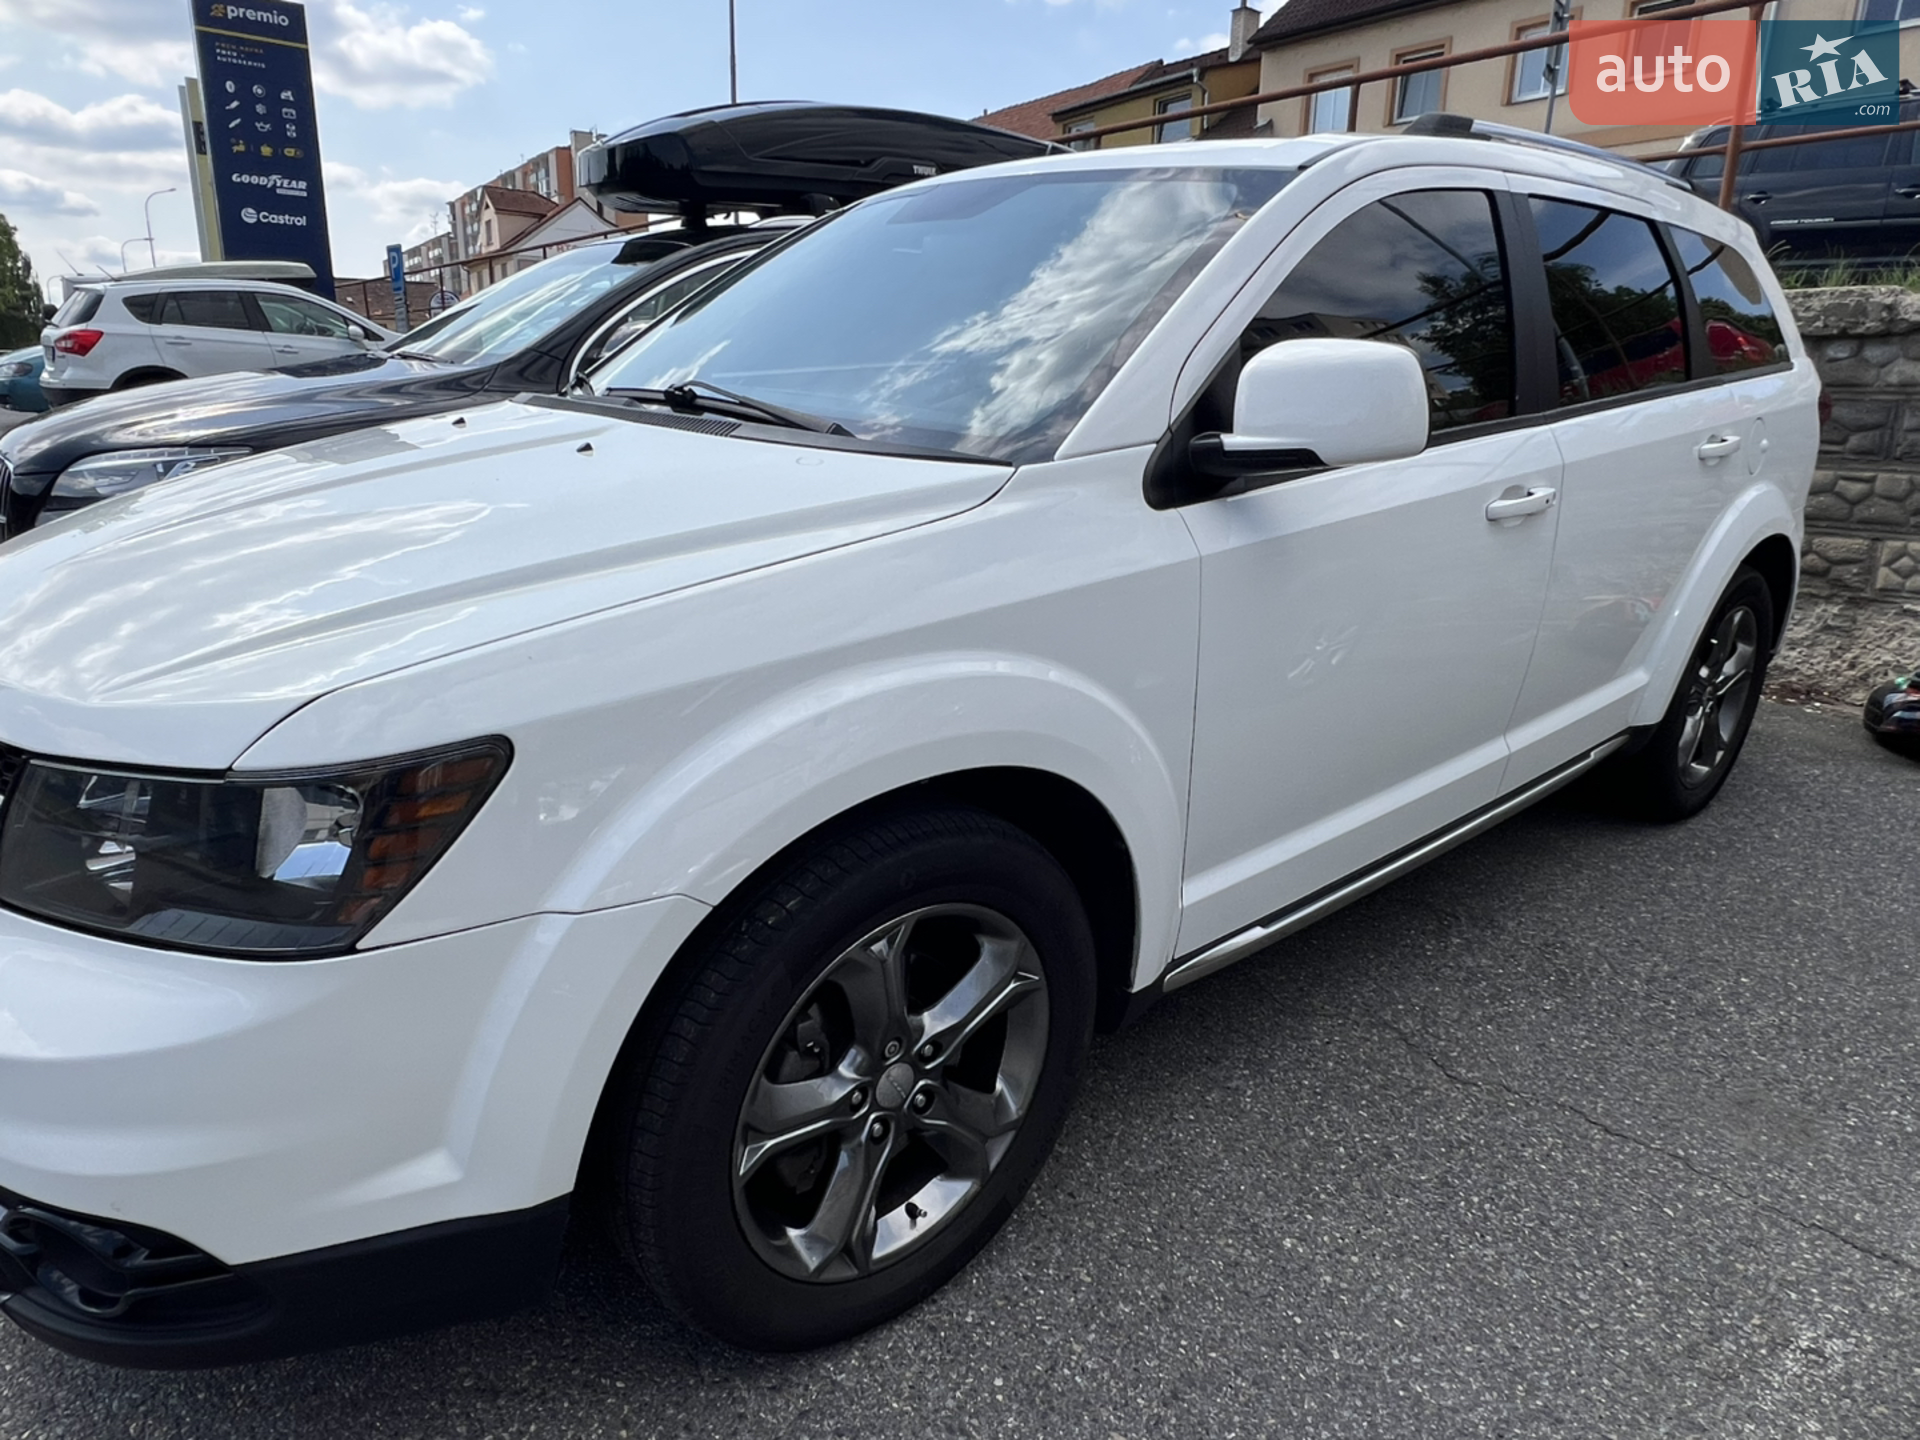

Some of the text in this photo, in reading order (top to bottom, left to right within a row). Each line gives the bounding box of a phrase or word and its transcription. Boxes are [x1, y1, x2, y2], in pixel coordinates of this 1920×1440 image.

[227, 5, 289, 26] premio
[912, 165, 937, 176] THULE
[231, 173, 307, 190] GOODYEAR
[259, 211, 307, 226] Castrol
[389, 251, 398, 279] P
